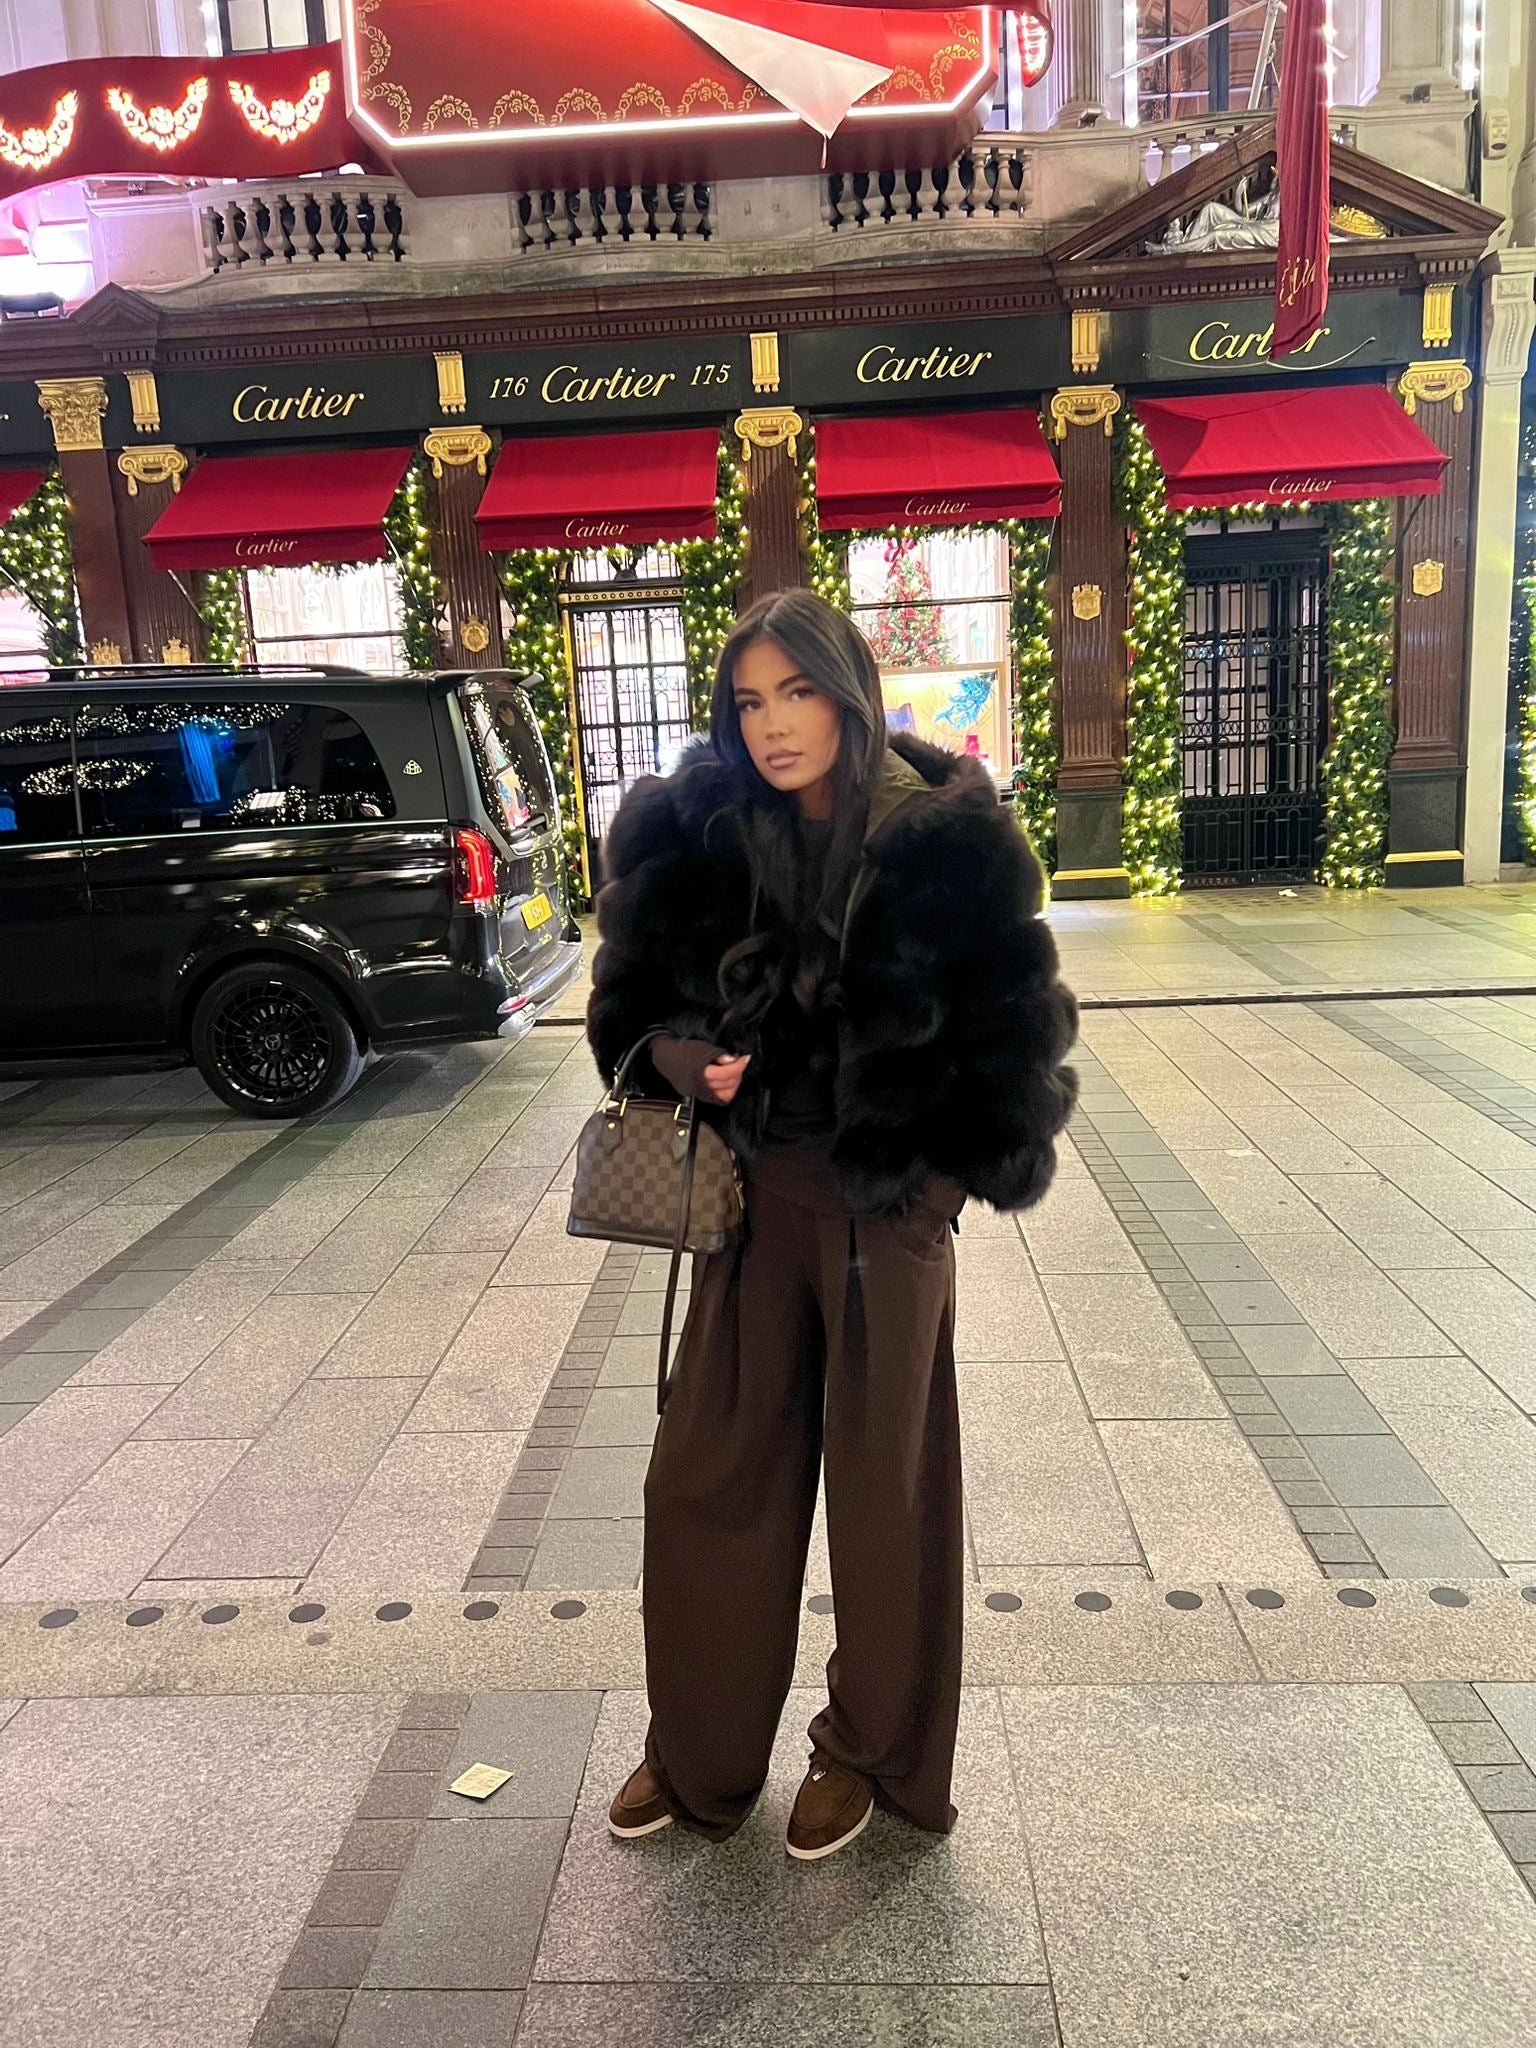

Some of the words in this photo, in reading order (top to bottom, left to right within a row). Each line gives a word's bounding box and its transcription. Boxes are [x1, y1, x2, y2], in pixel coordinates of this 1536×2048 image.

[1189, 321, 1331, 361] Cartr
[856, 345, 993, 383] Cartier
[489, 376, 529, 399] 176
[541, 365, 676, 404] Cartier
[690, 364, 732, 386] 175
[231, 384, 365, 423] Cartier
[1268, 475, 1337, 495] Cartier
[903, 496, 970, 517] Cartier
[565, 518, 629, 538] Cartier
[235, 537, 298, 557] Cartier
